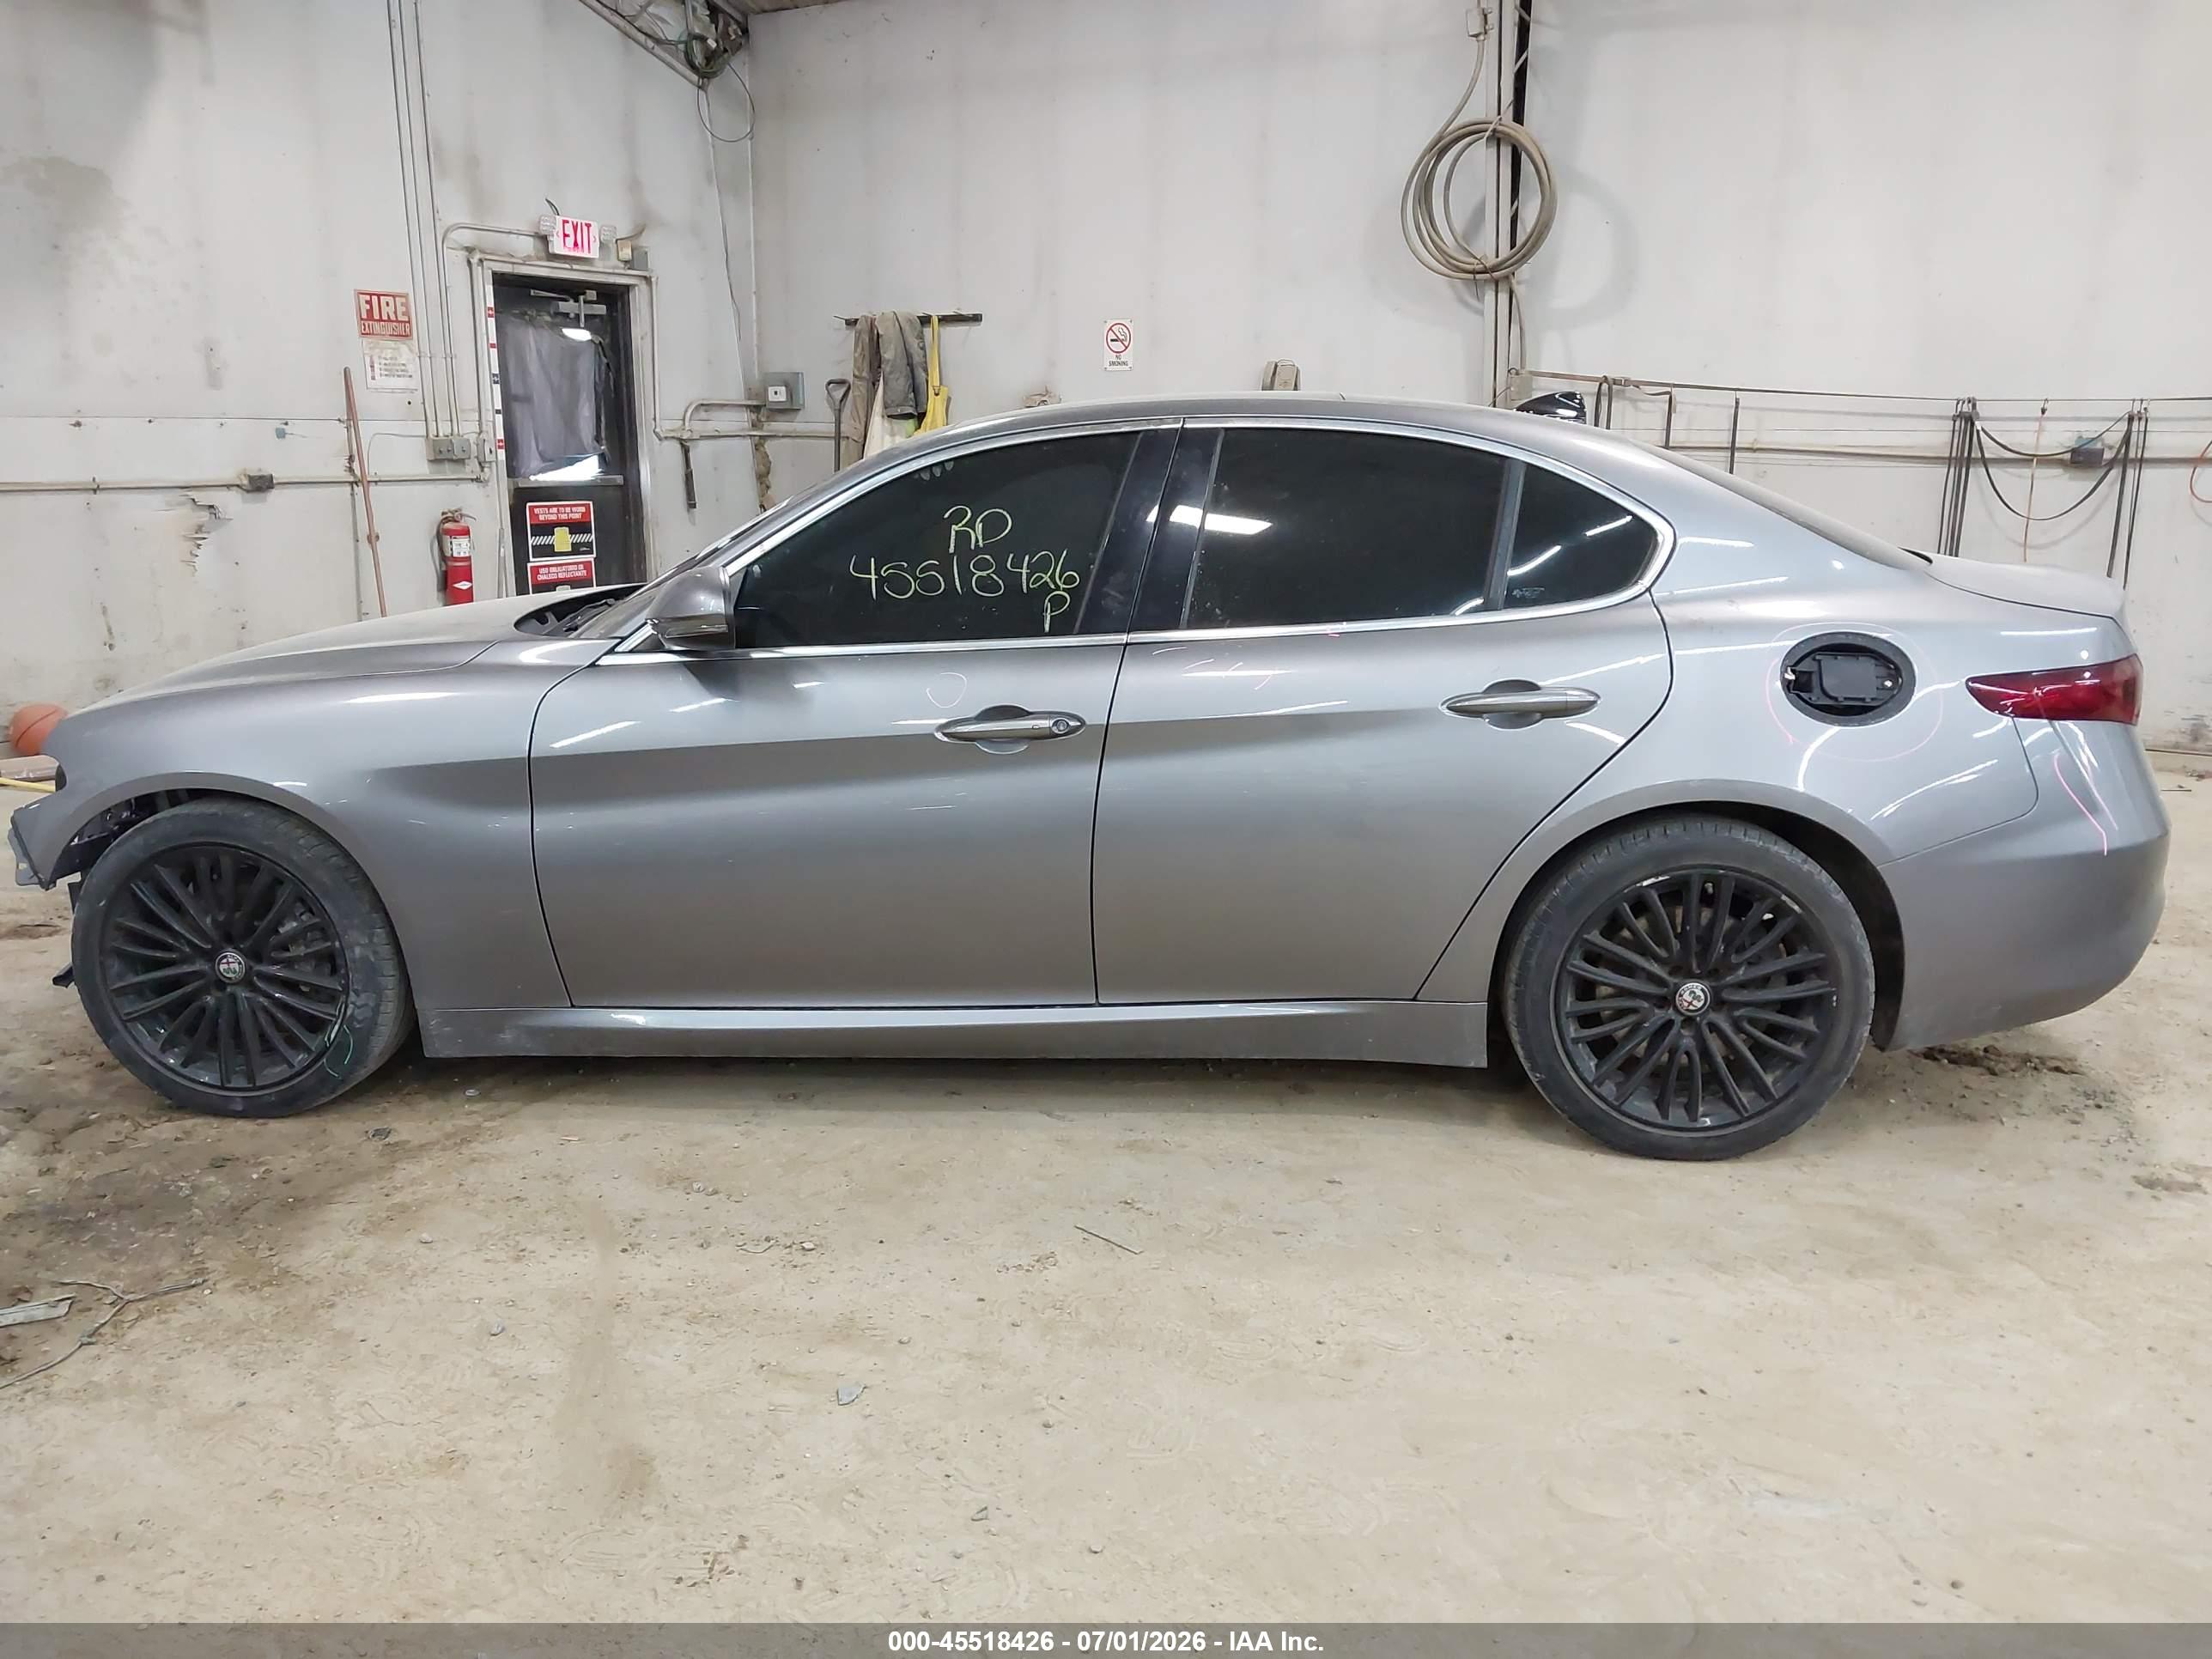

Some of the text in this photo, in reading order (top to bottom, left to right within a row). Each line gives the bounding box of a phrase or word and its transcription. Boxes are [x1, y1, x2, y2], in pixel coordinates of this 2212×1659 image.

[562, 219, 592, 254] EXIT
[359, 294, 409, 321] FIRE
[361, 320, 410, 336] EXTINGUISHER
[849, 548, 1081, 601] 45518426
[1042, 590, 1071, 633] P
